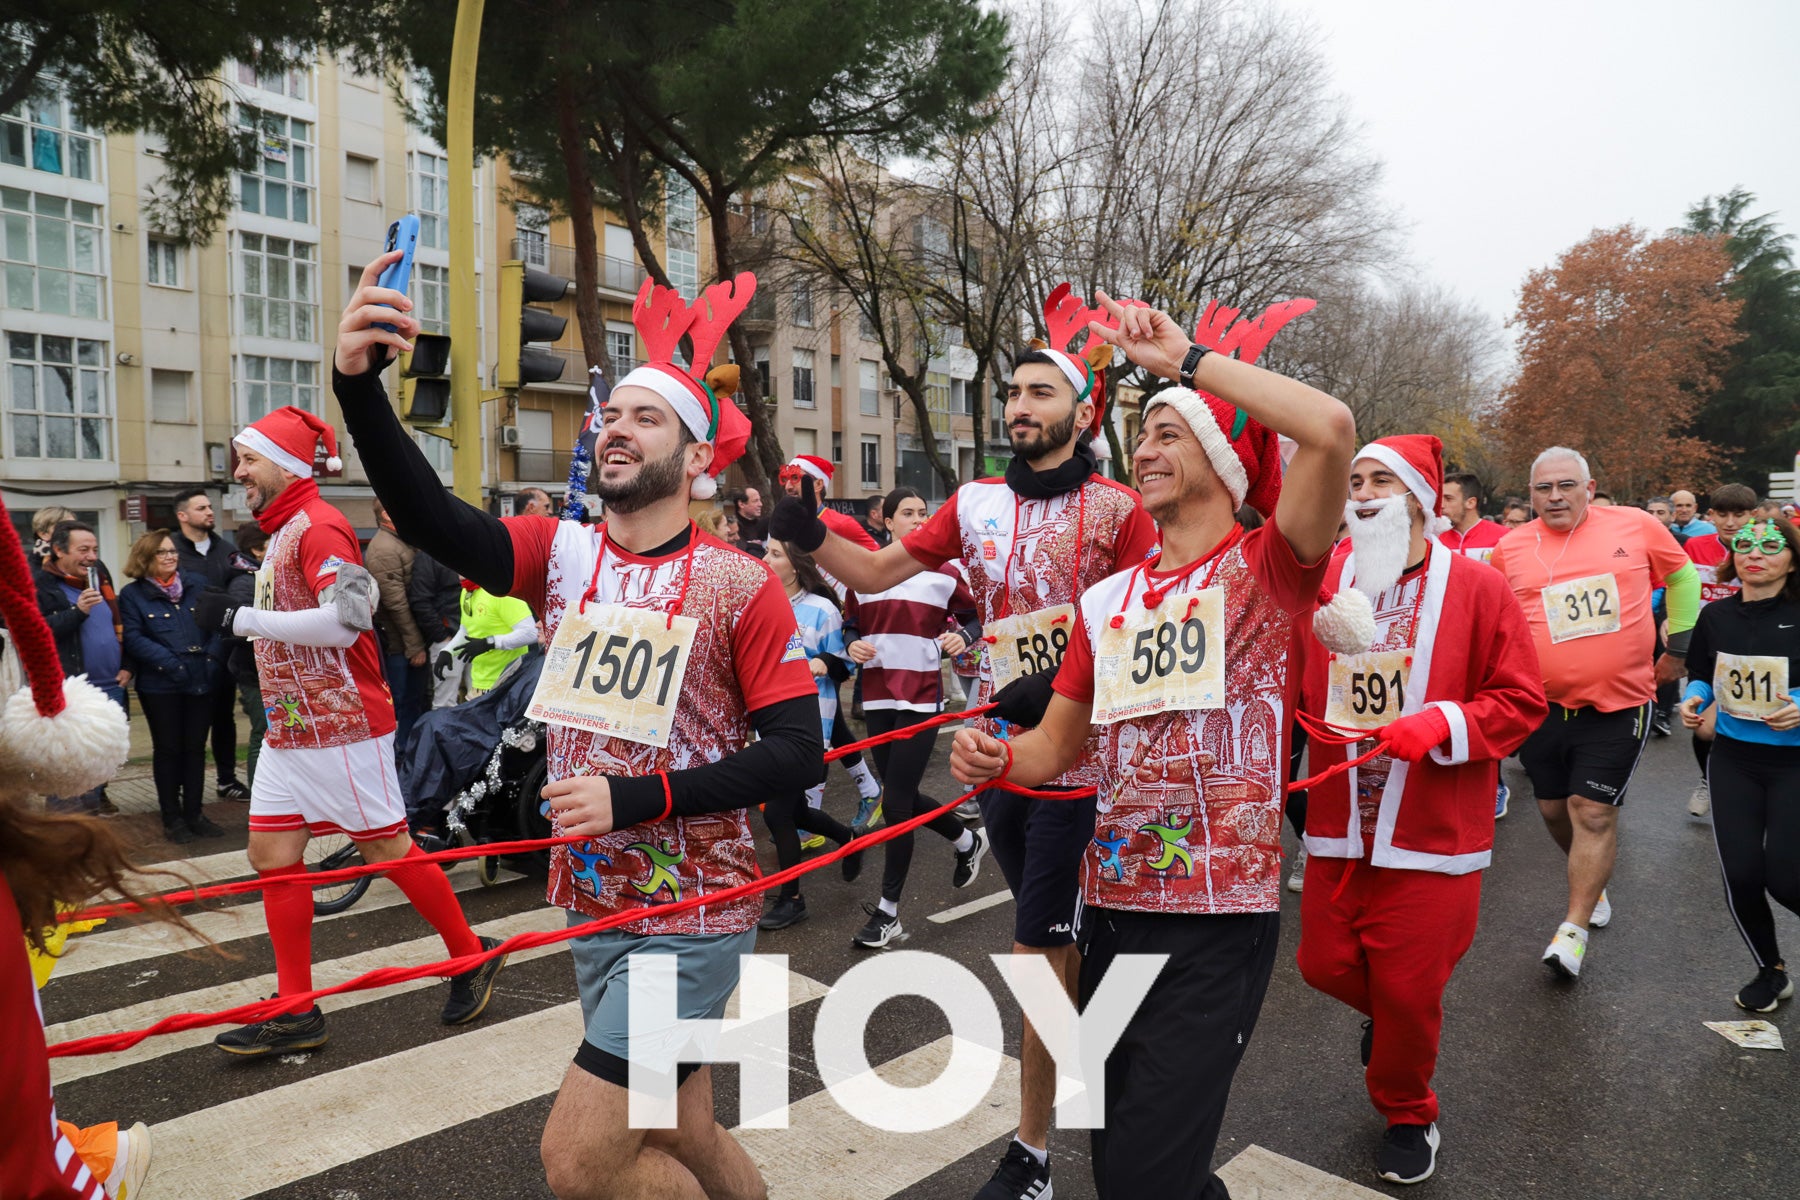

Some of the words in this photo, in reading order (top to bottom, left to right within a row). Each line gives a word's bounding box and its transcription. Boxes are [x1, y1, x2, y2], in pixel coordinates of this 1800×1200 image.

[1565, 588, 1611, 621] 312
[1131, 617, 1206, 685] 589
[572, 630, 680, 706] 1501
[1351, 669, 1404, 715] 591
[1729, 669, 1771, 702] 311
[542, 710, 611, 731] DOMBENITENSE
[1107, 700, 1166, 720] DOMBENITENSE
[1049, 923, 1070, 933] FILA
